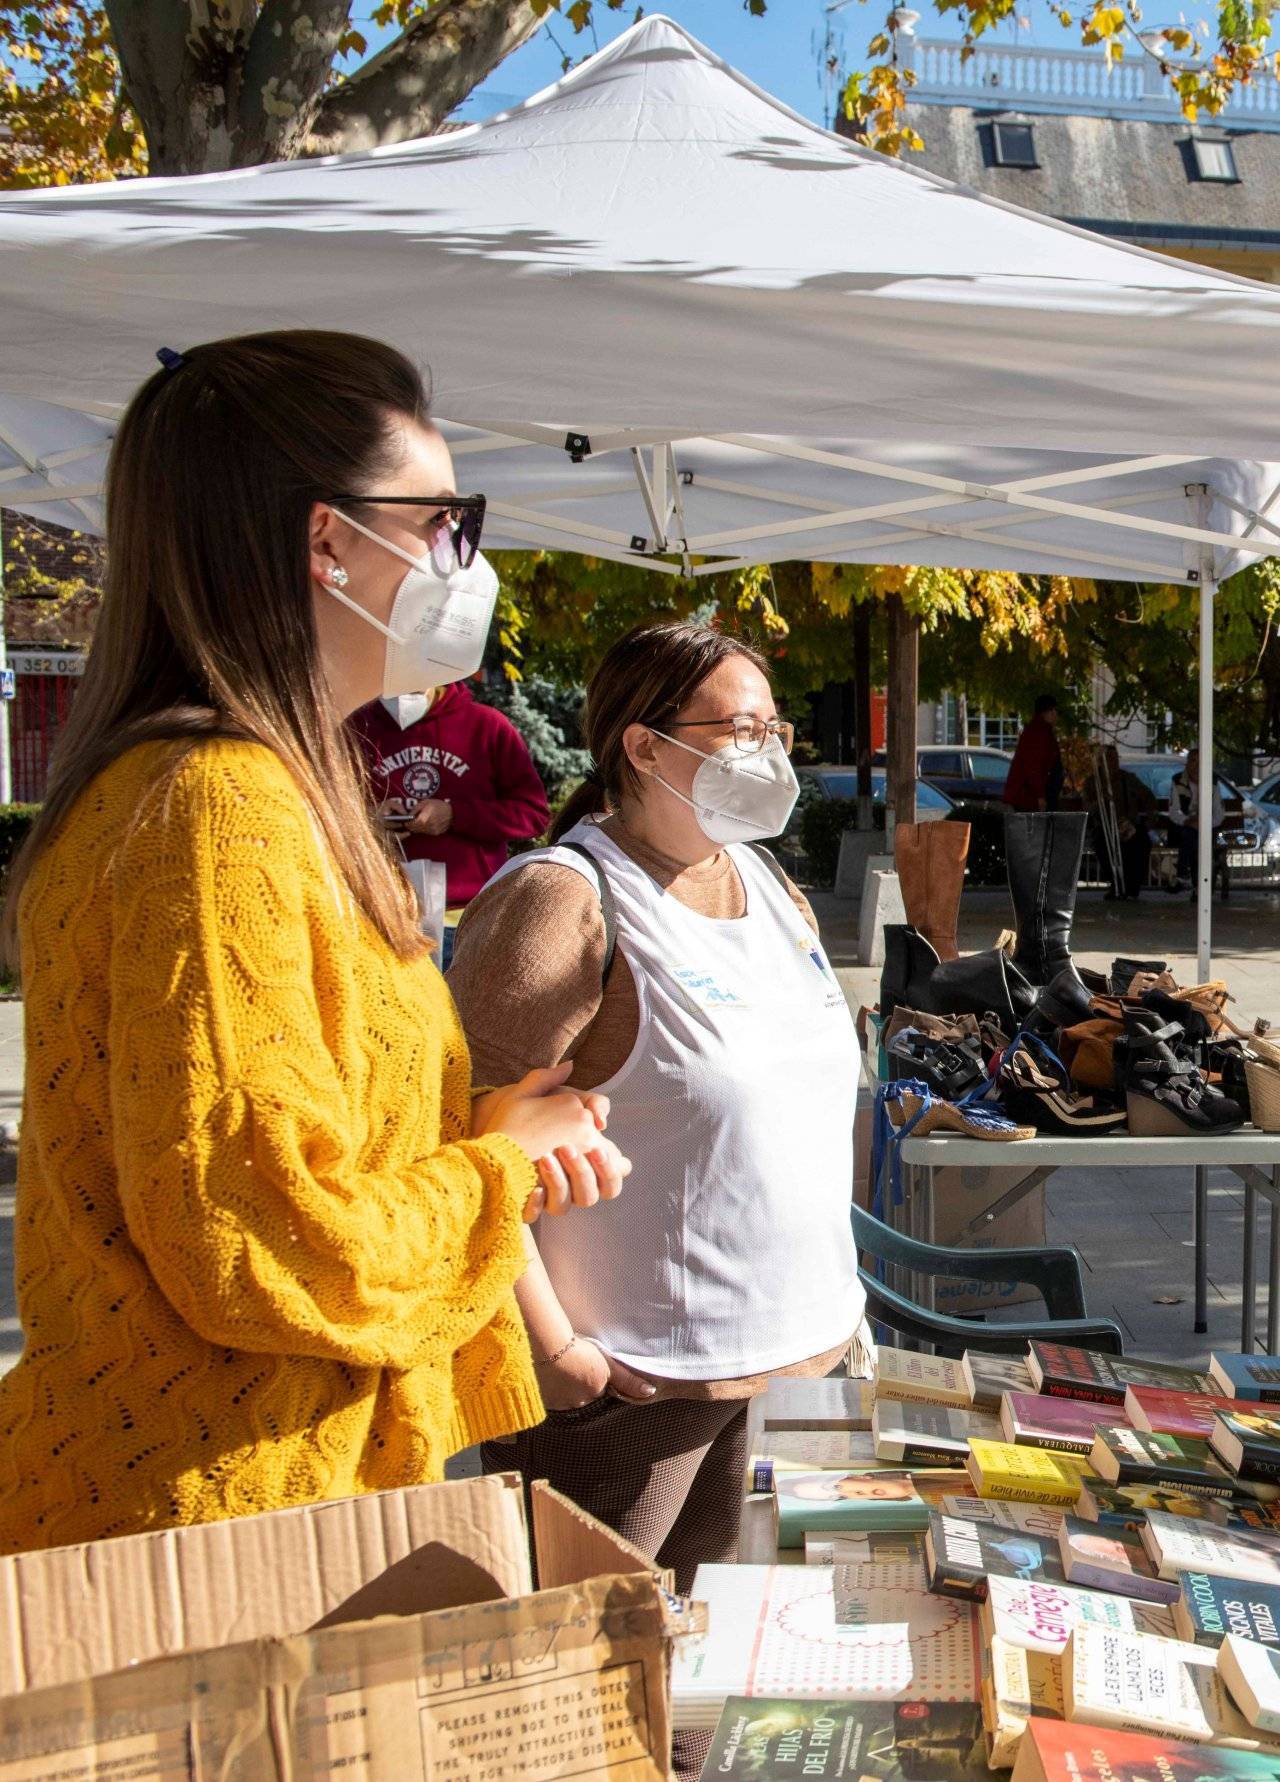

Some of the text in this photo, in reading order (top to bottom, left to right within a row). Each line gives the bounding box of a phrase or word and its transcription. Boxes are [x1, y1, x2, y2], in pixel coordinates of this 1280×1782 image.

[1037, 1438, 1094, 1455] UALQUIERA
[991, 1485, 1012, 1495] bien
[942, 1515, 983, 1568] ROBIN COOK
[1189, 1572, 1214, 1602] COOK
[1027, 1584, 1067, 1641] Carnegie
[1197, 1602, 1224, 1633] ROBIN
[1223, 1600, 1253, 1638] SIGNOS
[1249, 1602, 1279, 1641] VITALES
[1104, 1636, 1119, 1675] SIEMPRE
[1126, 1648, 1143, 1701] LLAMA DOS
[1149, 1669, 1163, 1697] VECES
[436, 1711, 487, 1732] PLEASE
[494, 1699, 546, 1721] REMOVE
[554, 1691, 583, 1706] THIS
[448, 1701, 622, 1749] SHIPPING BOX TO REVEAL
[434, 1757, 460, 1772] THE
[469, 1746, 510, 1764] TRULY
[517, 1727, 594, 1754] ATTRACTIVE
[479, 1767, 503, 1782] FOR
[512, 1750, 575, 1774] IN-STORE
[582, 1735, 633, 1756] DISPLAY
[775, 1728, 803, 1762] HIJAS
[803, 1717, 835, 1775] DEL FRÍO
